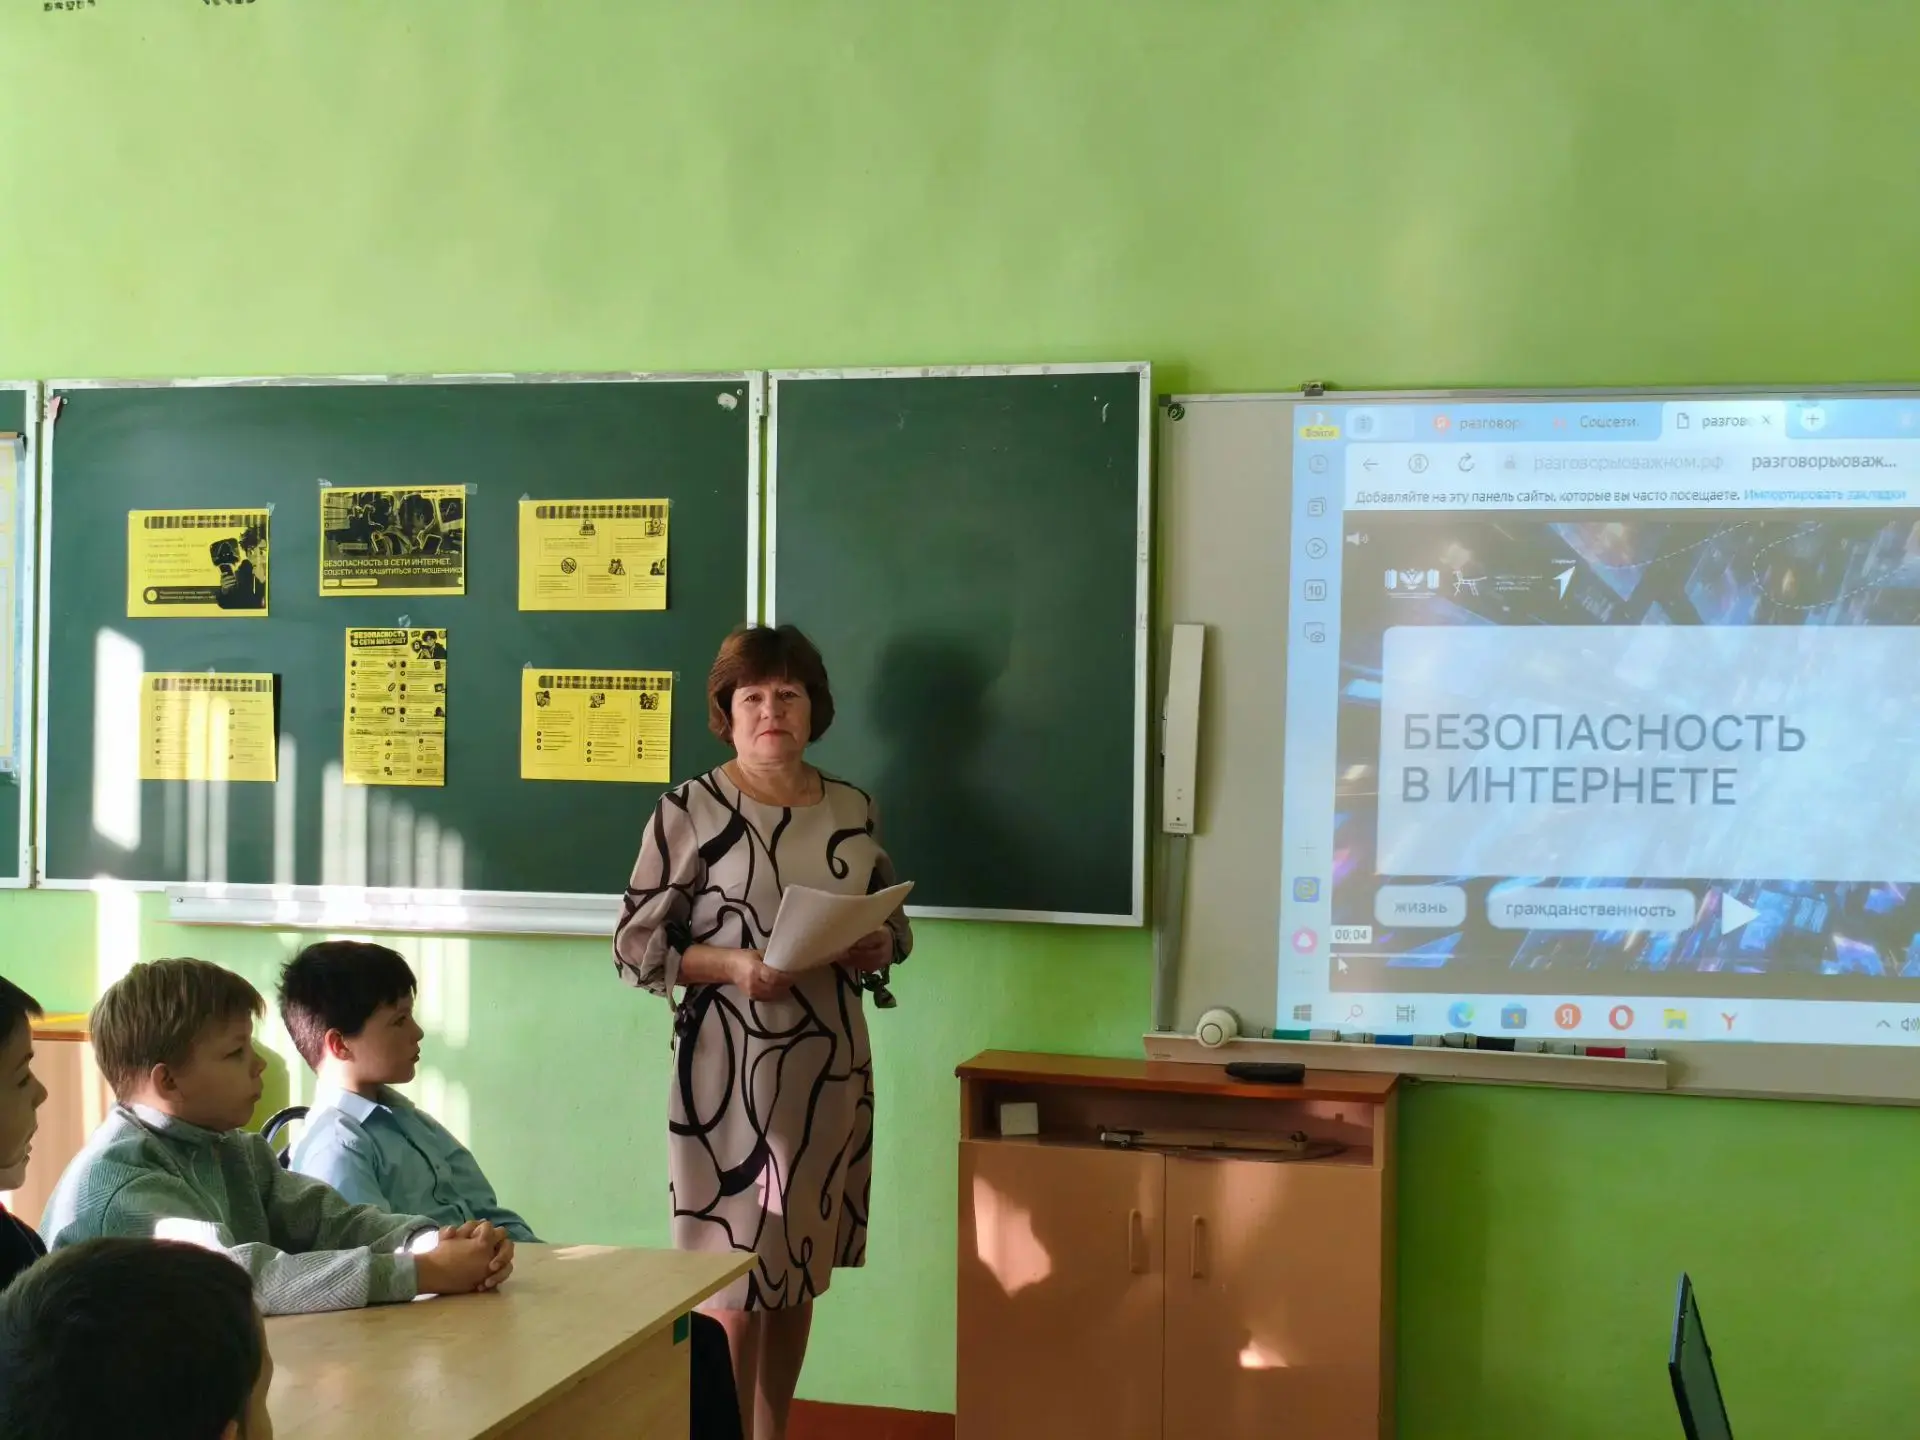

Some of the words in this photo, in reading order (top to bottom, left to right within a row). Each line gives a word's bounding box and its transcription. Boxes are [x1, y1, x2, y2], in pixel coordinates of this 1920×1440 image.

[1534, 456, 1723, 472] разговорыоважном.рф
[1356, 490, 1429, 505] Добавляйте
[1432, 493, 1447, 503] на
[1449, 493, 1469, 506] эту
[1472, 492, 1514, 503] панель
[1517, 490, 1555, 504] сайты,
[1560, 492, 1611, 504] которые
[1614, 491, 1631, 501] вы
[1633, 491, 1667, 502] часто
[1670, 490, 1740, 503] посещаете.
[1744, 489, 1843, 502] Импортировать
[1847, 490, 1907, 501] закладки
[324, 559, 382, 567] БЕЗОПАСНОСТЬ
[1403, 712, 1807, 753] БЕЗОПАСНОСТЬ
[1402, 765, 1431, 803] В
[1447, 765, 1738, 806] ИНТЕРНЕТЕ
[1394, 901, 1448, 916] жизнь
[1505, 902, 1677, 920] гражданственность
[1334, 929, 1368, 943] 00:04
